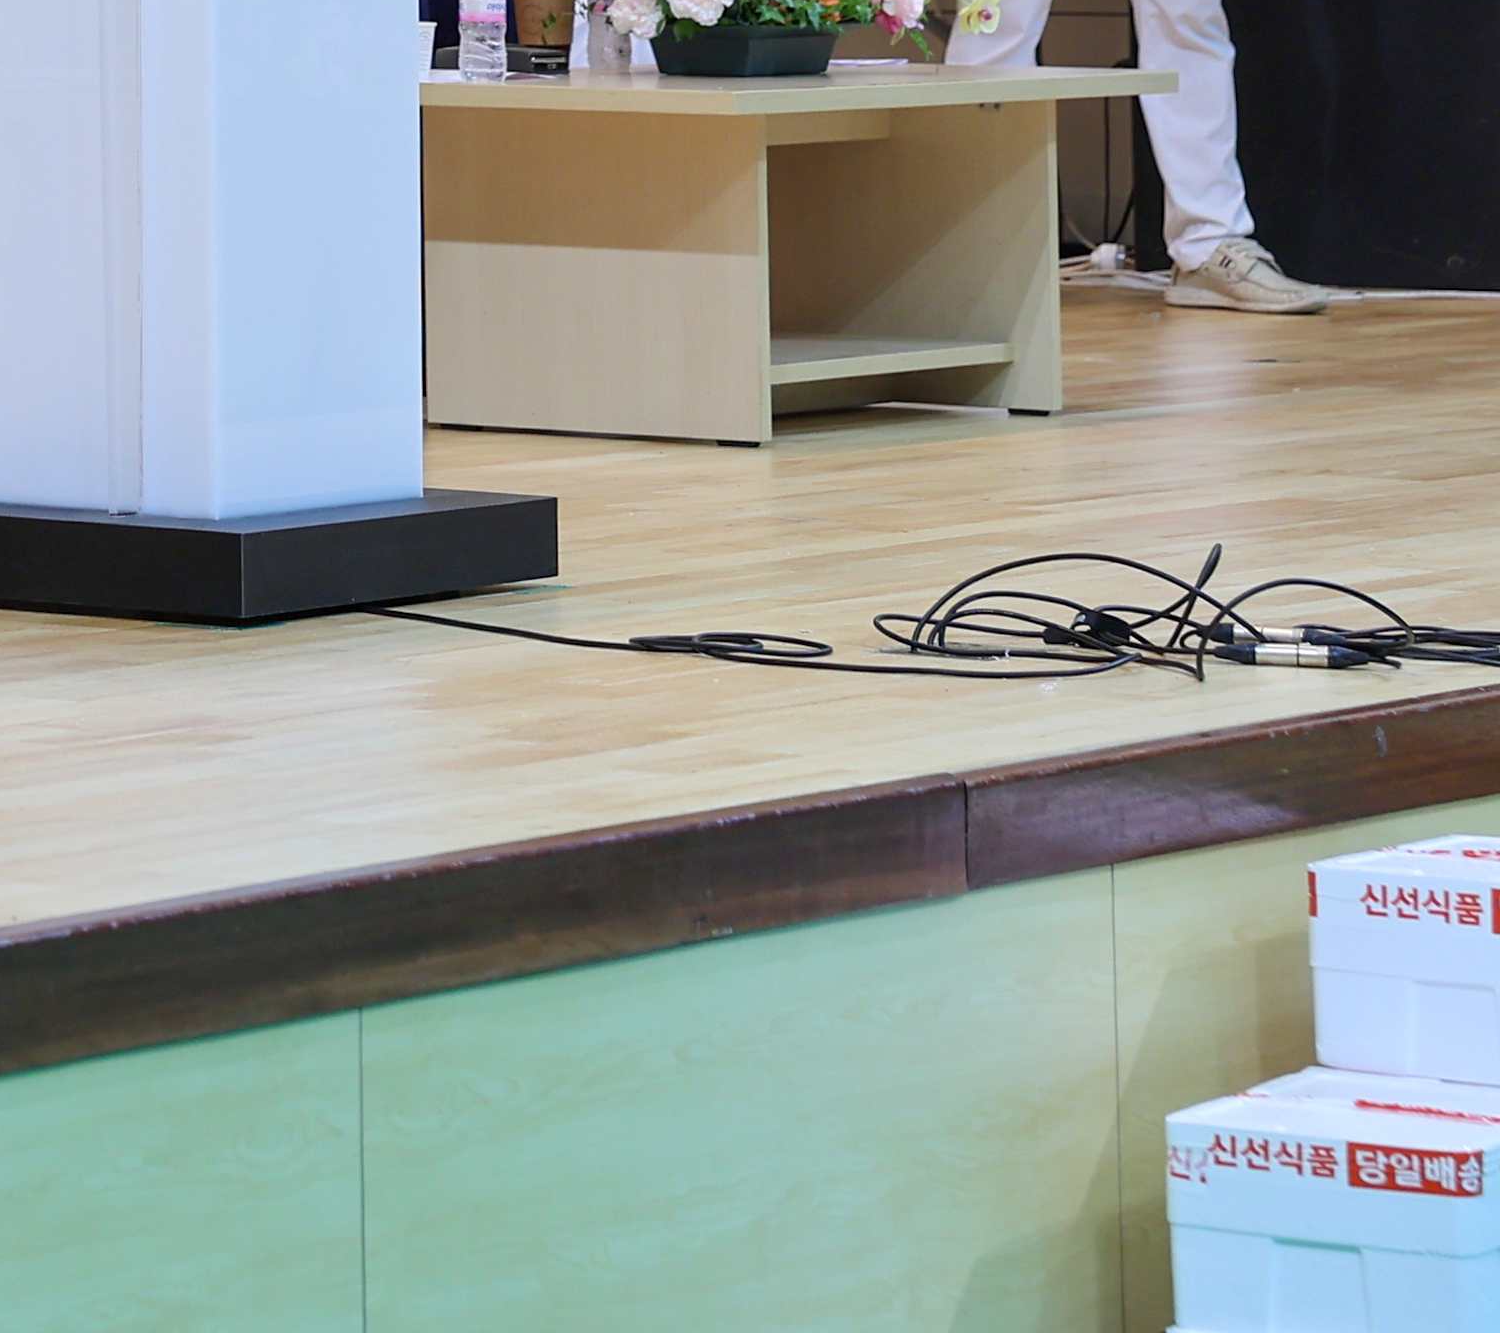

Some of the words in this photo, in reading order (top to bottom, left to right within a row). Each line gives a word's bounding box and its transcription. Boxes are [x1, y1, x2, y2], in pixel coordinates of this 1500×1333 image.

[1360, 884, 1484, 927] 신선식품
[1207, 1133, 1339, 1179] 신선식품
[1355, 1148, 1482, 1192] 당일배송
